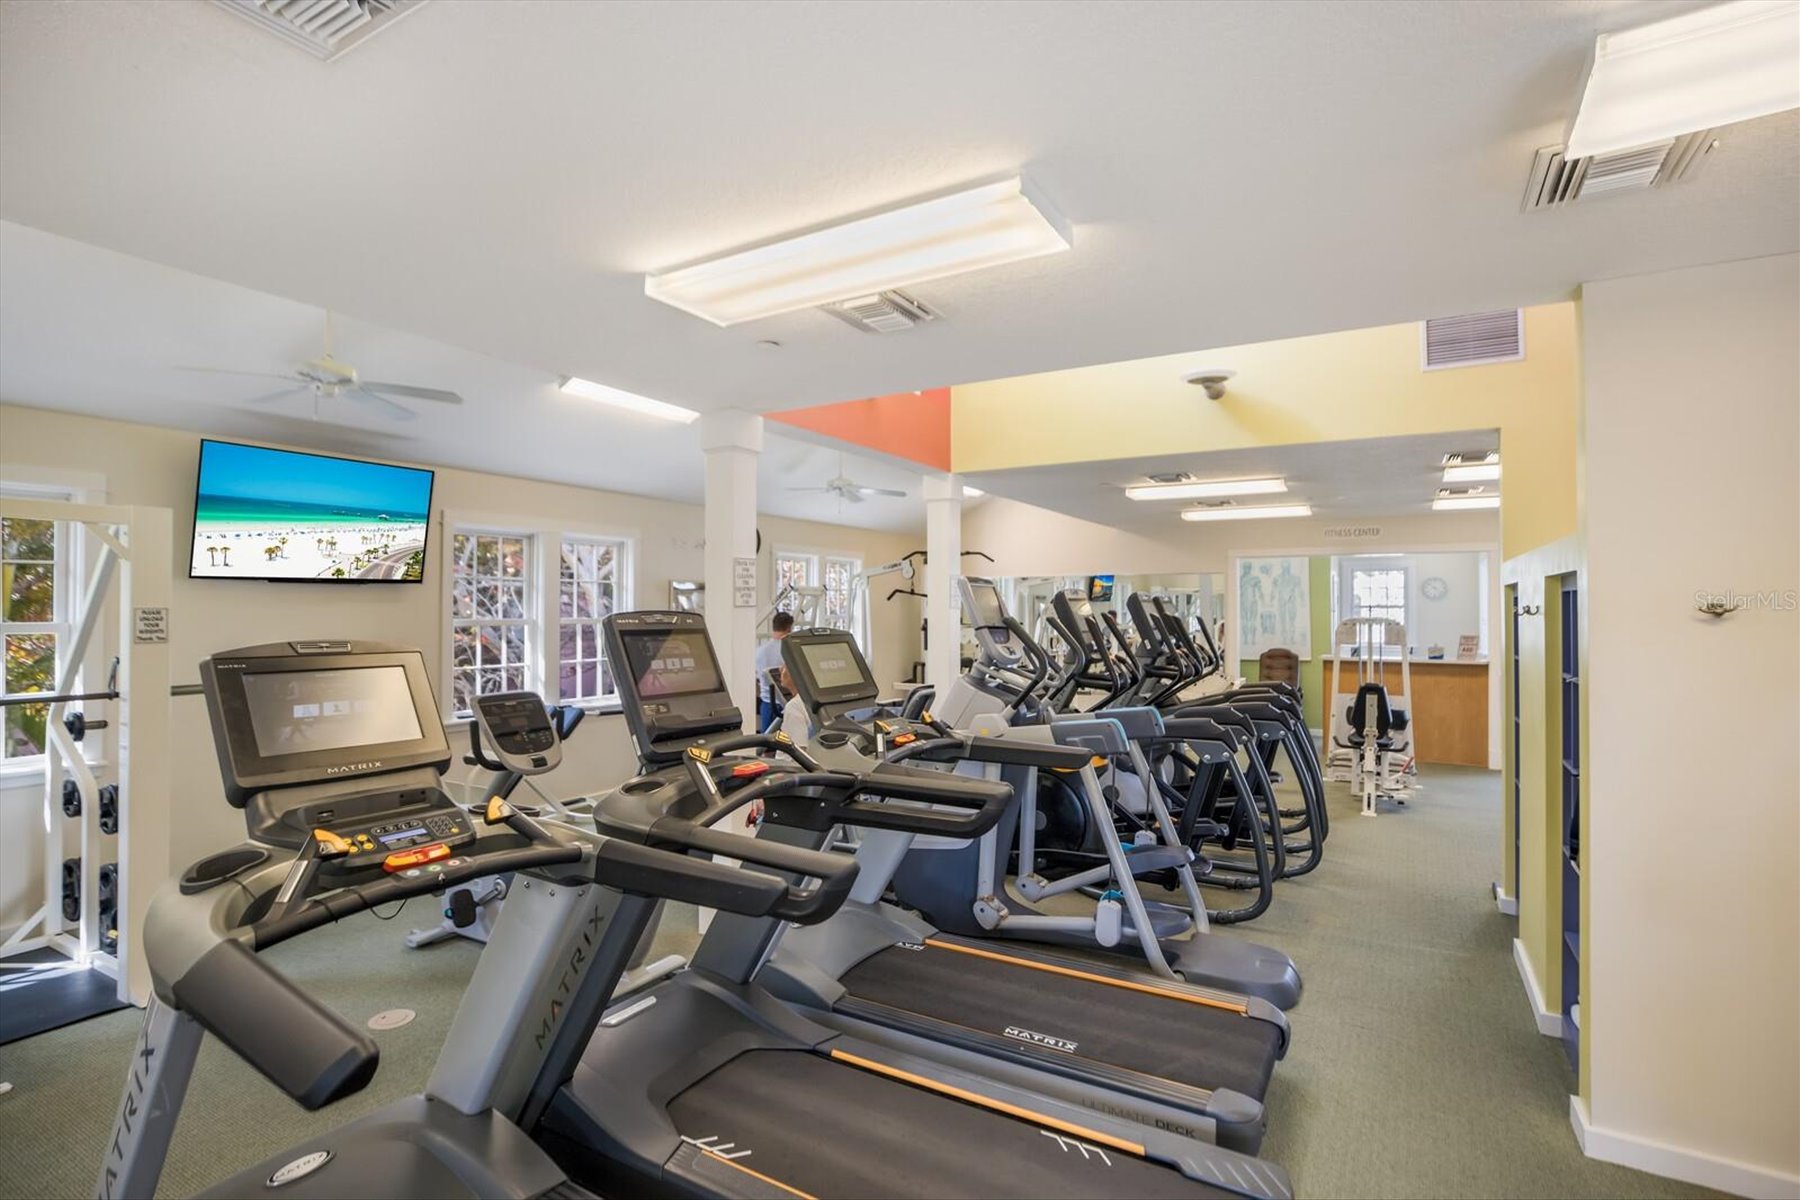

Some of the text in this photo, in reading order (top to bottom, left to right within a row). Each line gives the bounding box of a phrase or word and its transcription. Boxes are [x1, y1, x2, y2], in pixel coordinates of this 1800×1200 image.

[1324, 527, 1380, 537] FITNESS CENTER
[327, 761, 381, 774] MATRIX
[535, 904, 605, 1050] MATRIX
[1004, 1026, 1077, 1051] MATRIX
[99, 1031, 155, 1200] ATRIX
[1154, 1117, 1196, 1138] DECK
[274, 1153, 325, 1180] MATRIX
